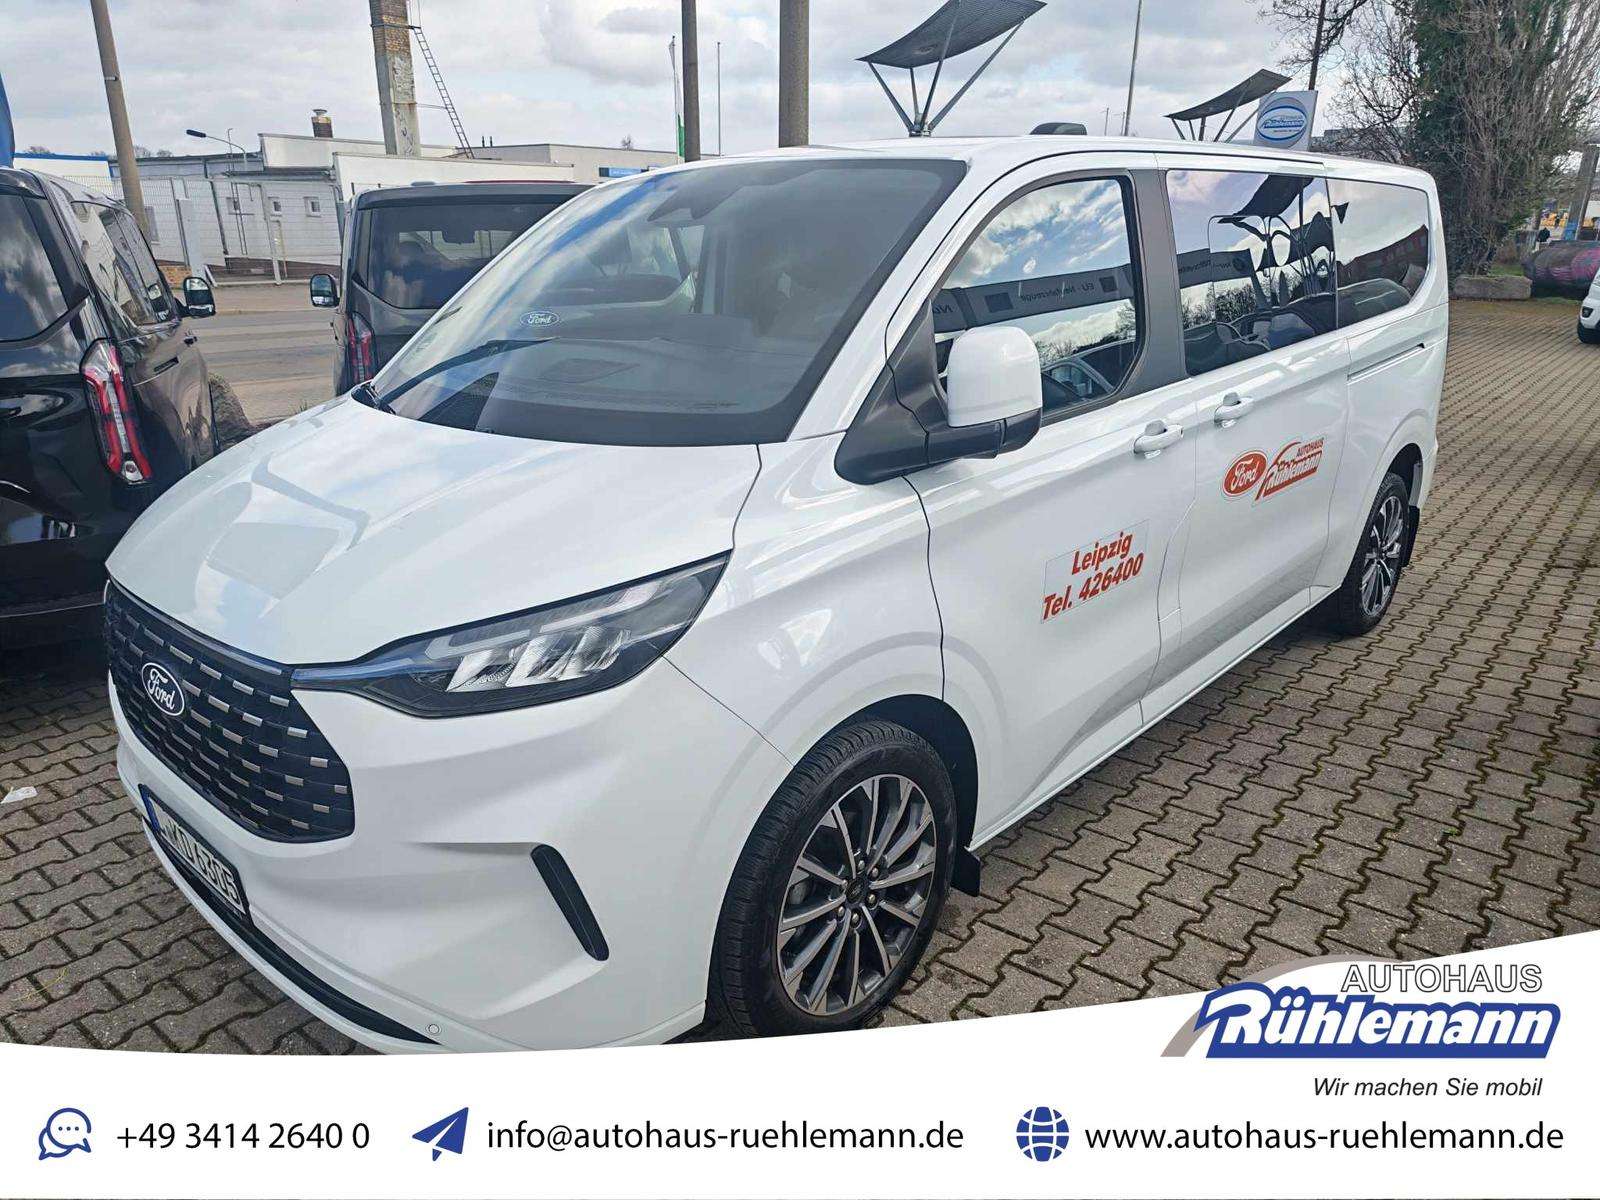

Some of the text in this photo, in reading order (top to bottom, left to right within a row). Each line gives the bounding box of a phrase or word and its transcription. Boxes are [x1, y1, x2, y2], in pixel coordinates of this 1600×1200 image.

[1230, 457, 1260, 492] Ford
[1071, 531, 1133, 576] Leipzig
[1043, 552, 1144, 620] Tel. 426400
[149, 667, 177, 711] Ford
